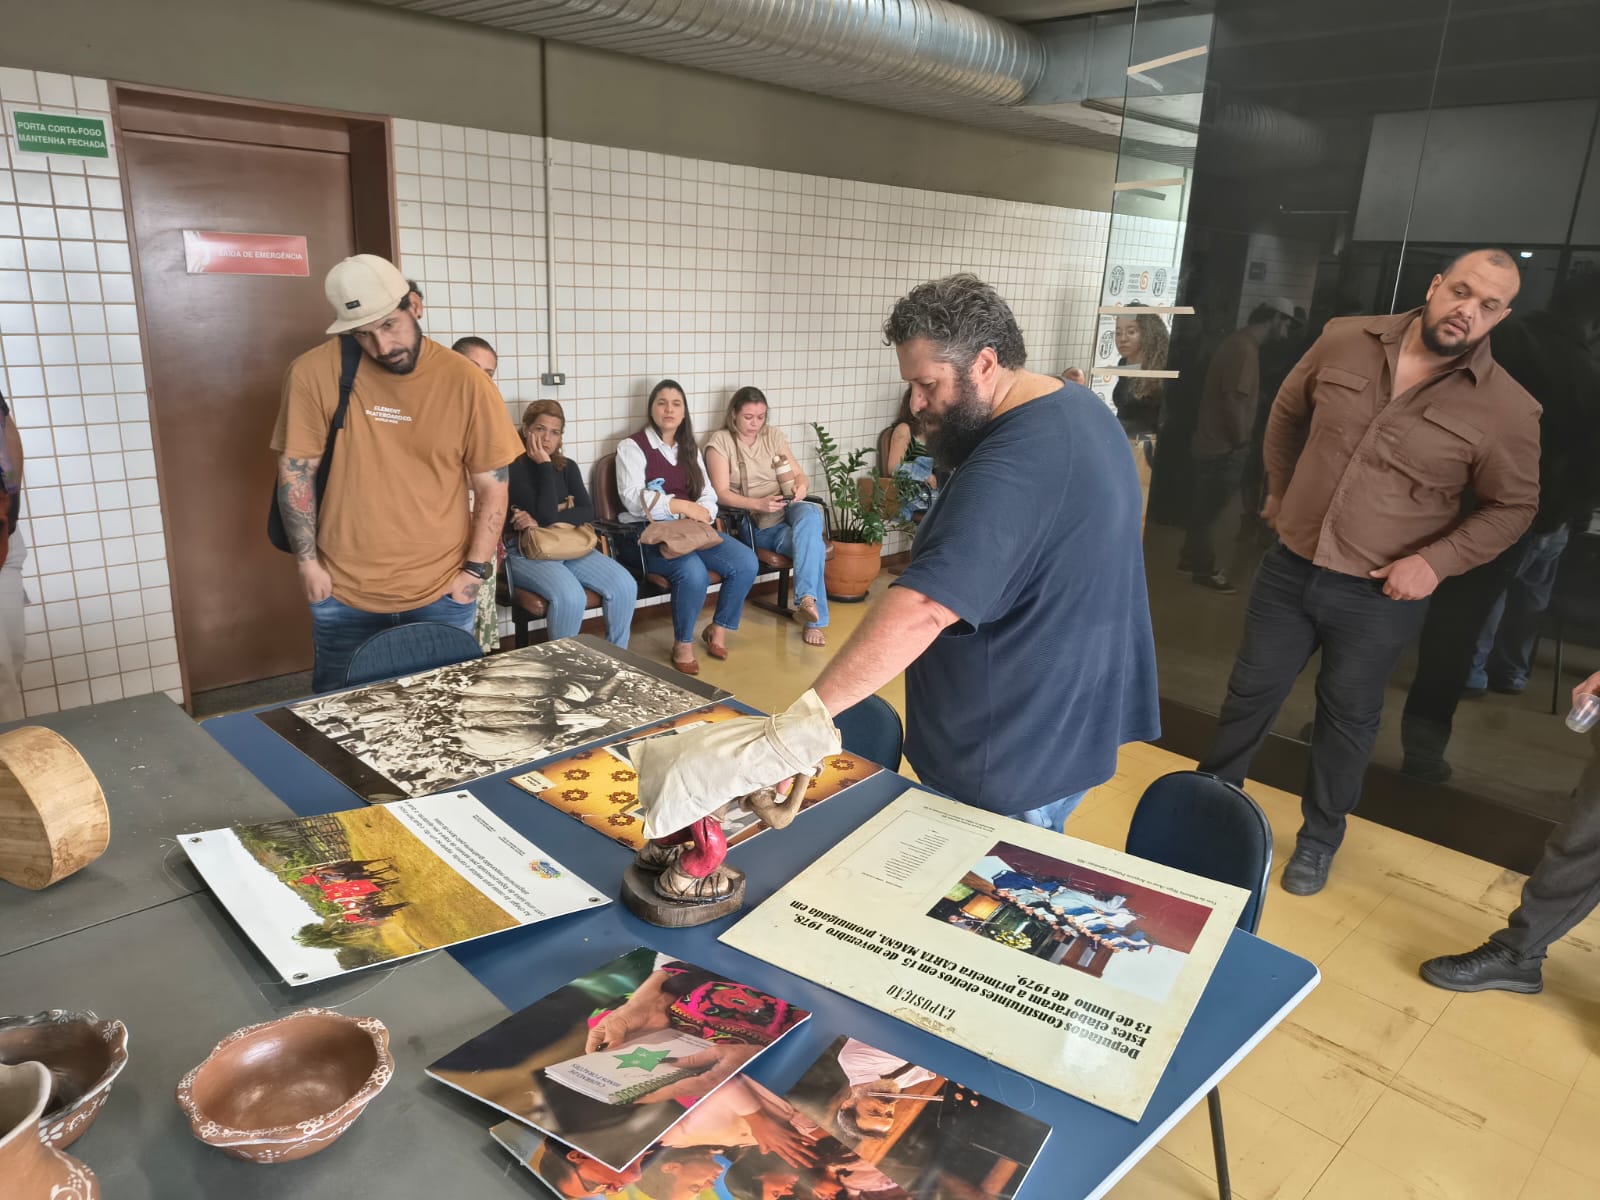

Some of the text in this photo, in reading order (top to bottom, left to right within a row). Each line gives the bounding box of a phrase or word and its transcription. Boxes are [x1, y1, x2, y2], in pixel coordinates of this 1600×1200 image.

[17, 121, 102, 137] PORTA CORTA-FOGO
[18, 134, 106, 149] MANTENHA FECHADA
[242, 250, 254, 258] DE
[790, 900, 808, 911] em
[808, 908, 877, 938] promulgada
[826, 928, 883, 954] novembro
[883, 950, 899, 960] de
[901, 958, 917, 968] 15
[920, 951, 957, 971] CARTA
[917, 963, 938, 975] em
[937, 972, 980, 992] eleitos
[959, 966, 1016, 994] primeira
[886, 985, 956, 1020] EXPOSIÇÃO
[1017, 989, 1027, 998] a
[980, 989, 1063, 1028] Constituintes
[1017, 975, 1152, 1034] 13 de junho de 1979.
[1028, 994, 1109, 1031] elaboraram
[1064, 1022, 1141, 1060] Deputados
[1112, 1027, 1147, 1047] Estes
